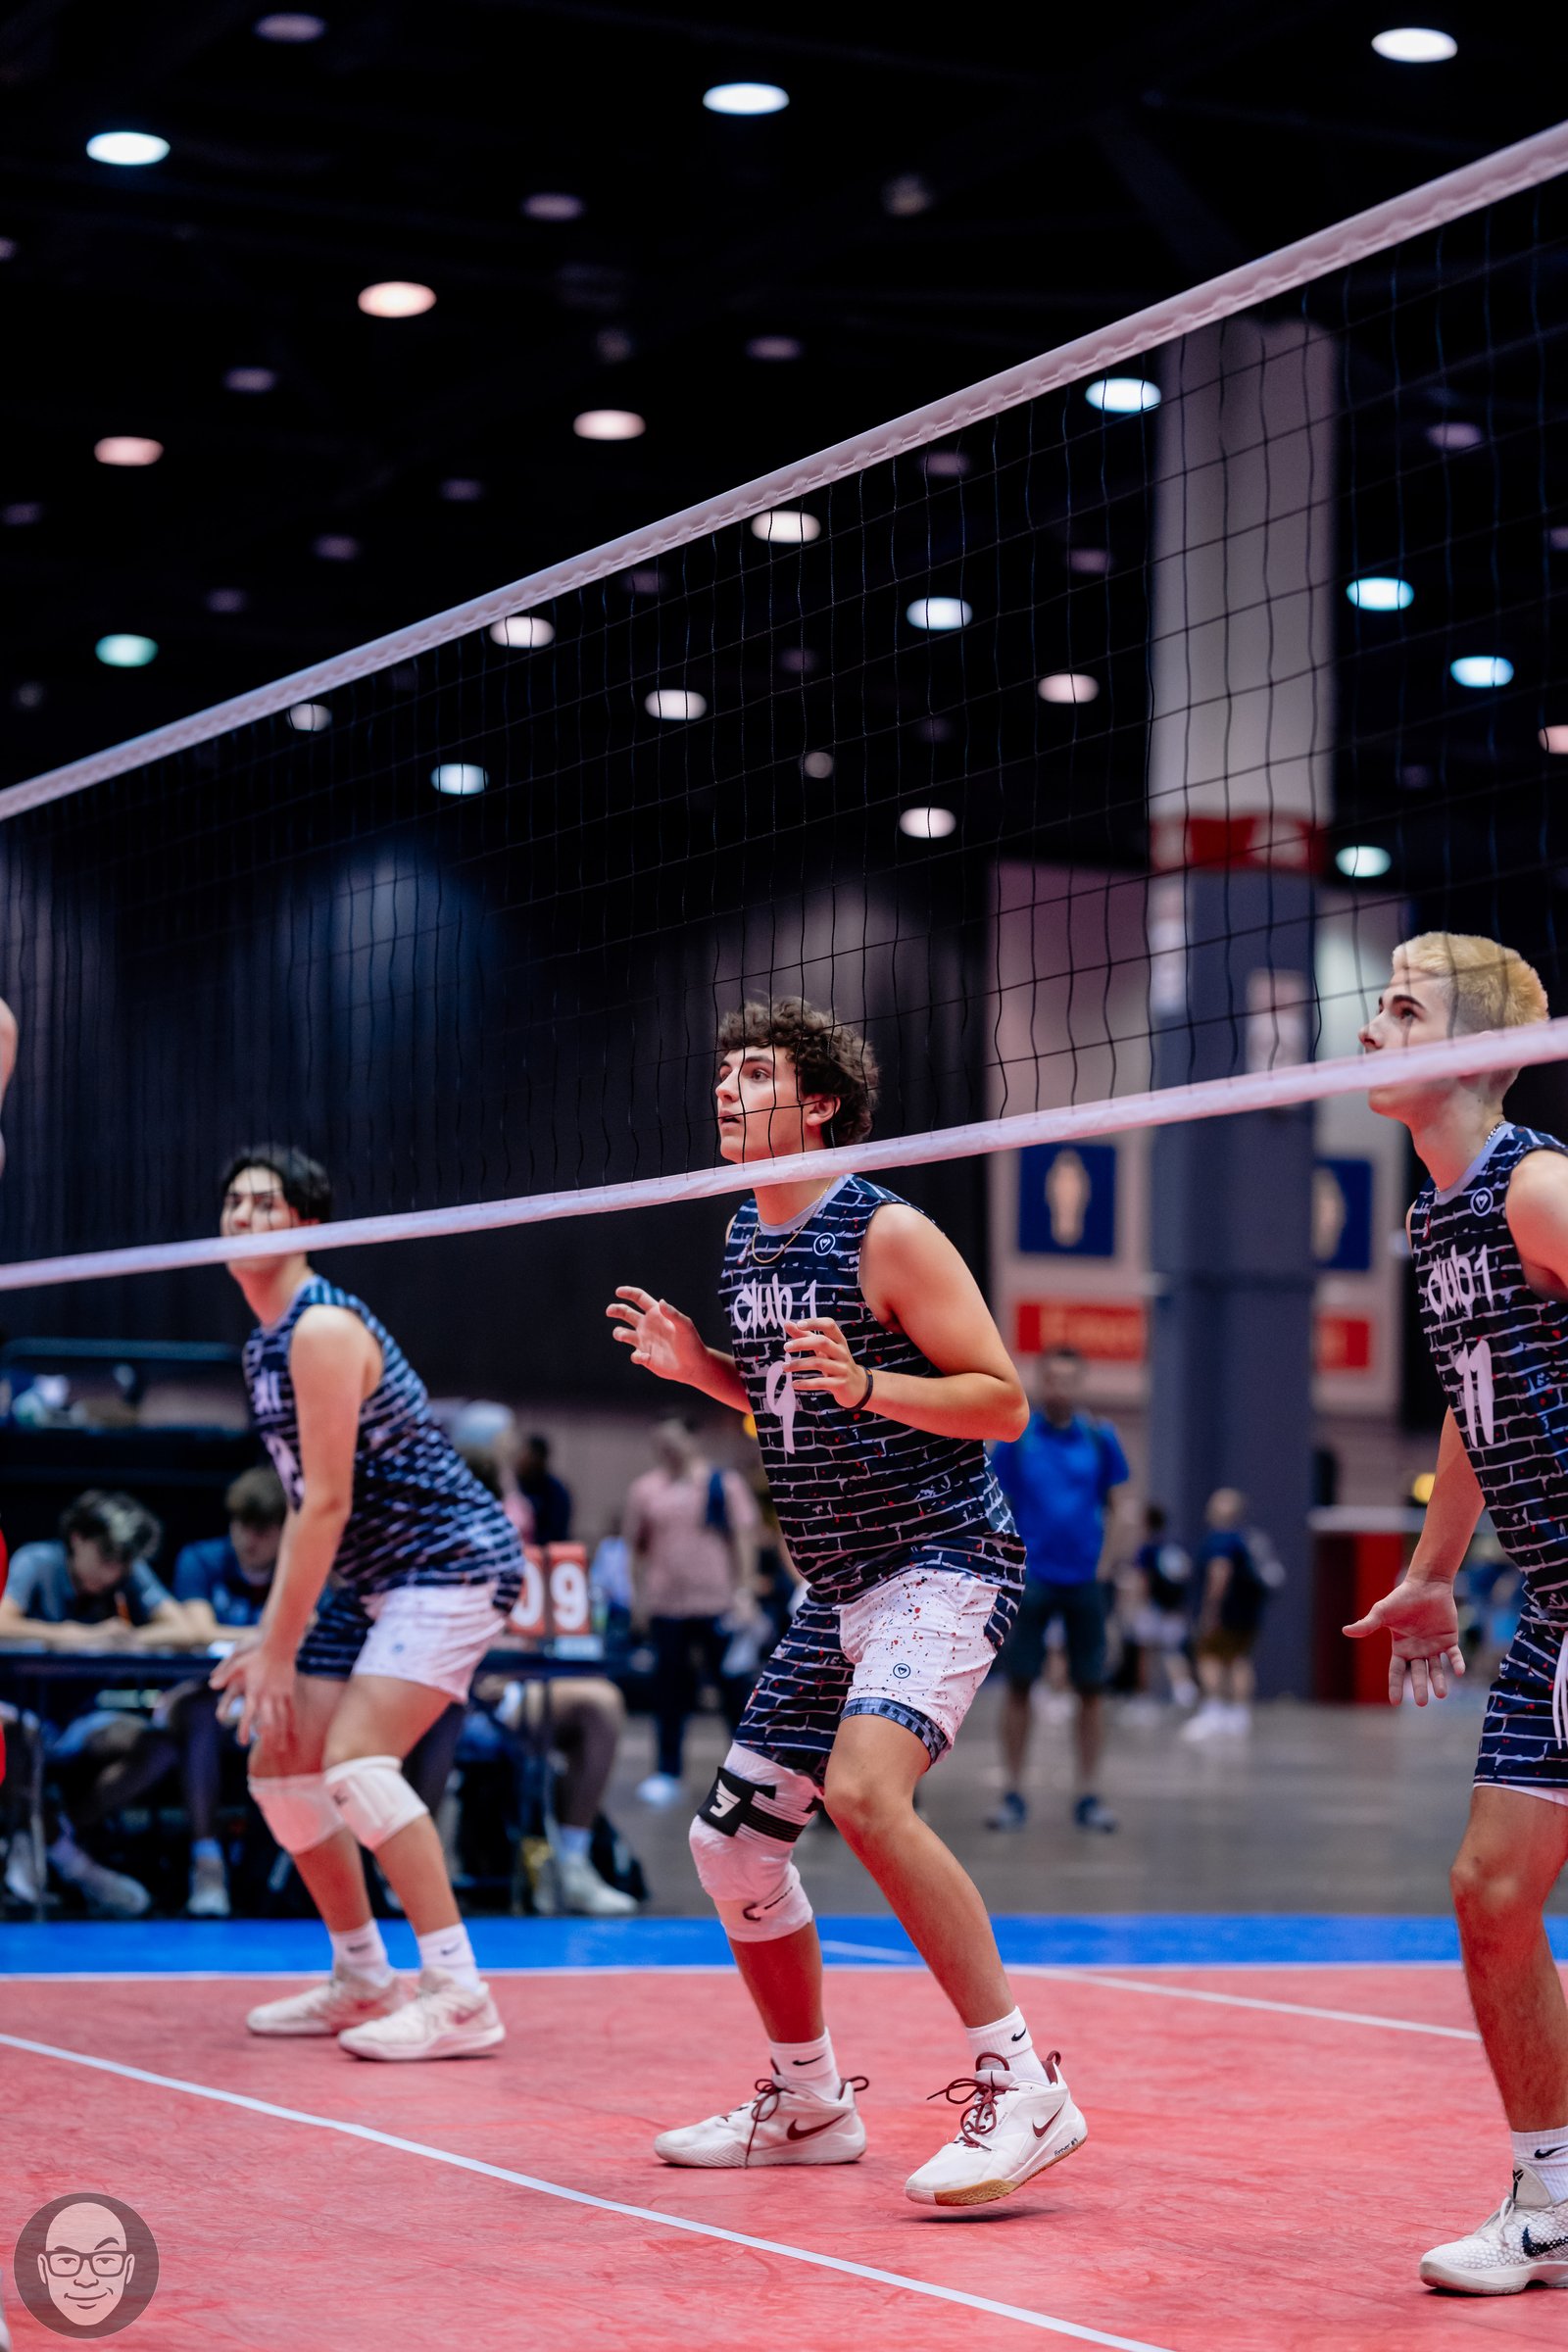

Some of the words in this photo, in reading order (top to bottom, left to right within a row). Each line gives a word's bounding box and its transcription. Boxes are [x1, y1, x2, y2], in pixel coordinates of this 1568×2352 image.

[1474, 1244, 1494, 1311] 1
[765, 1351, 796, 1455] 9
[1454, 1339, 1494, 1448] 11
